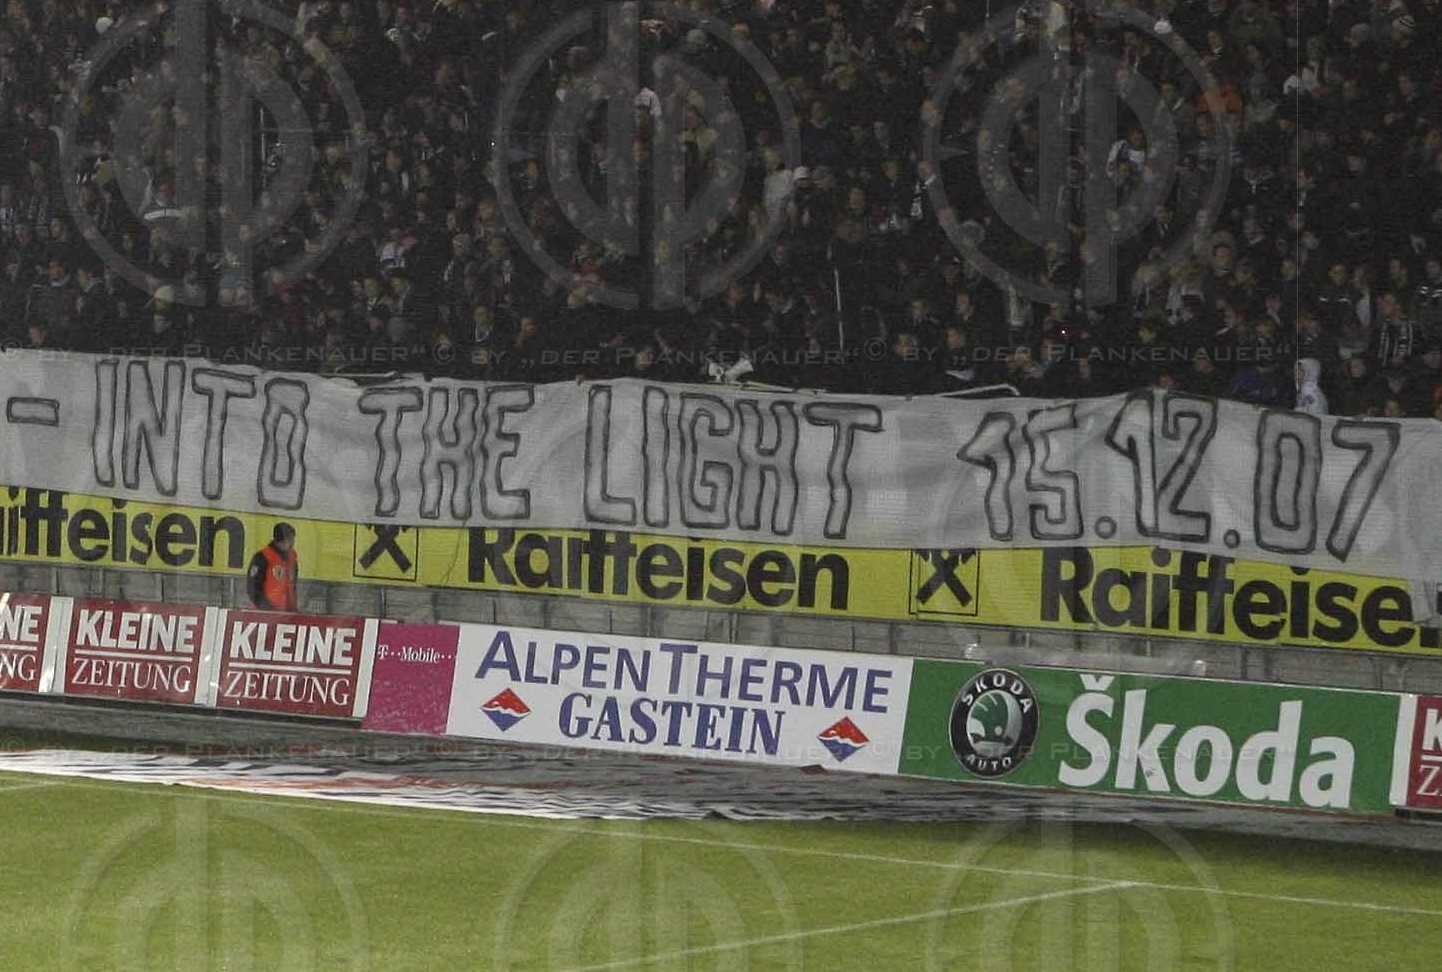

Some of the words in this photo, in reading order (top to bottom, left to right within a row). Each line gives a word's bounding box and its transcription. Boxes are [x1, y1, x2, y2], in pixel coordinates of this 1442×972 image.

[92, 358, 310, 510] INTO
[358, 384, 535, 520] THE
[582, 384, 885, 540] LIGHT
[959, 390, 1402, 562] 15.12.07
[468, 527, 849, 610] Raiffeisen
[76, 609, 198, 653] KLEINE
[230, 621, 356, 666] KLEINE
[71, 658, 191, 692] ZEITUNG
[224, 670, 350, 705] ZEITUNG
[558, 692, 785, 756] GASTEIN
[1059, 674, 1355, 809] Škoda
[967, 754, 1012, 770] AUTO
